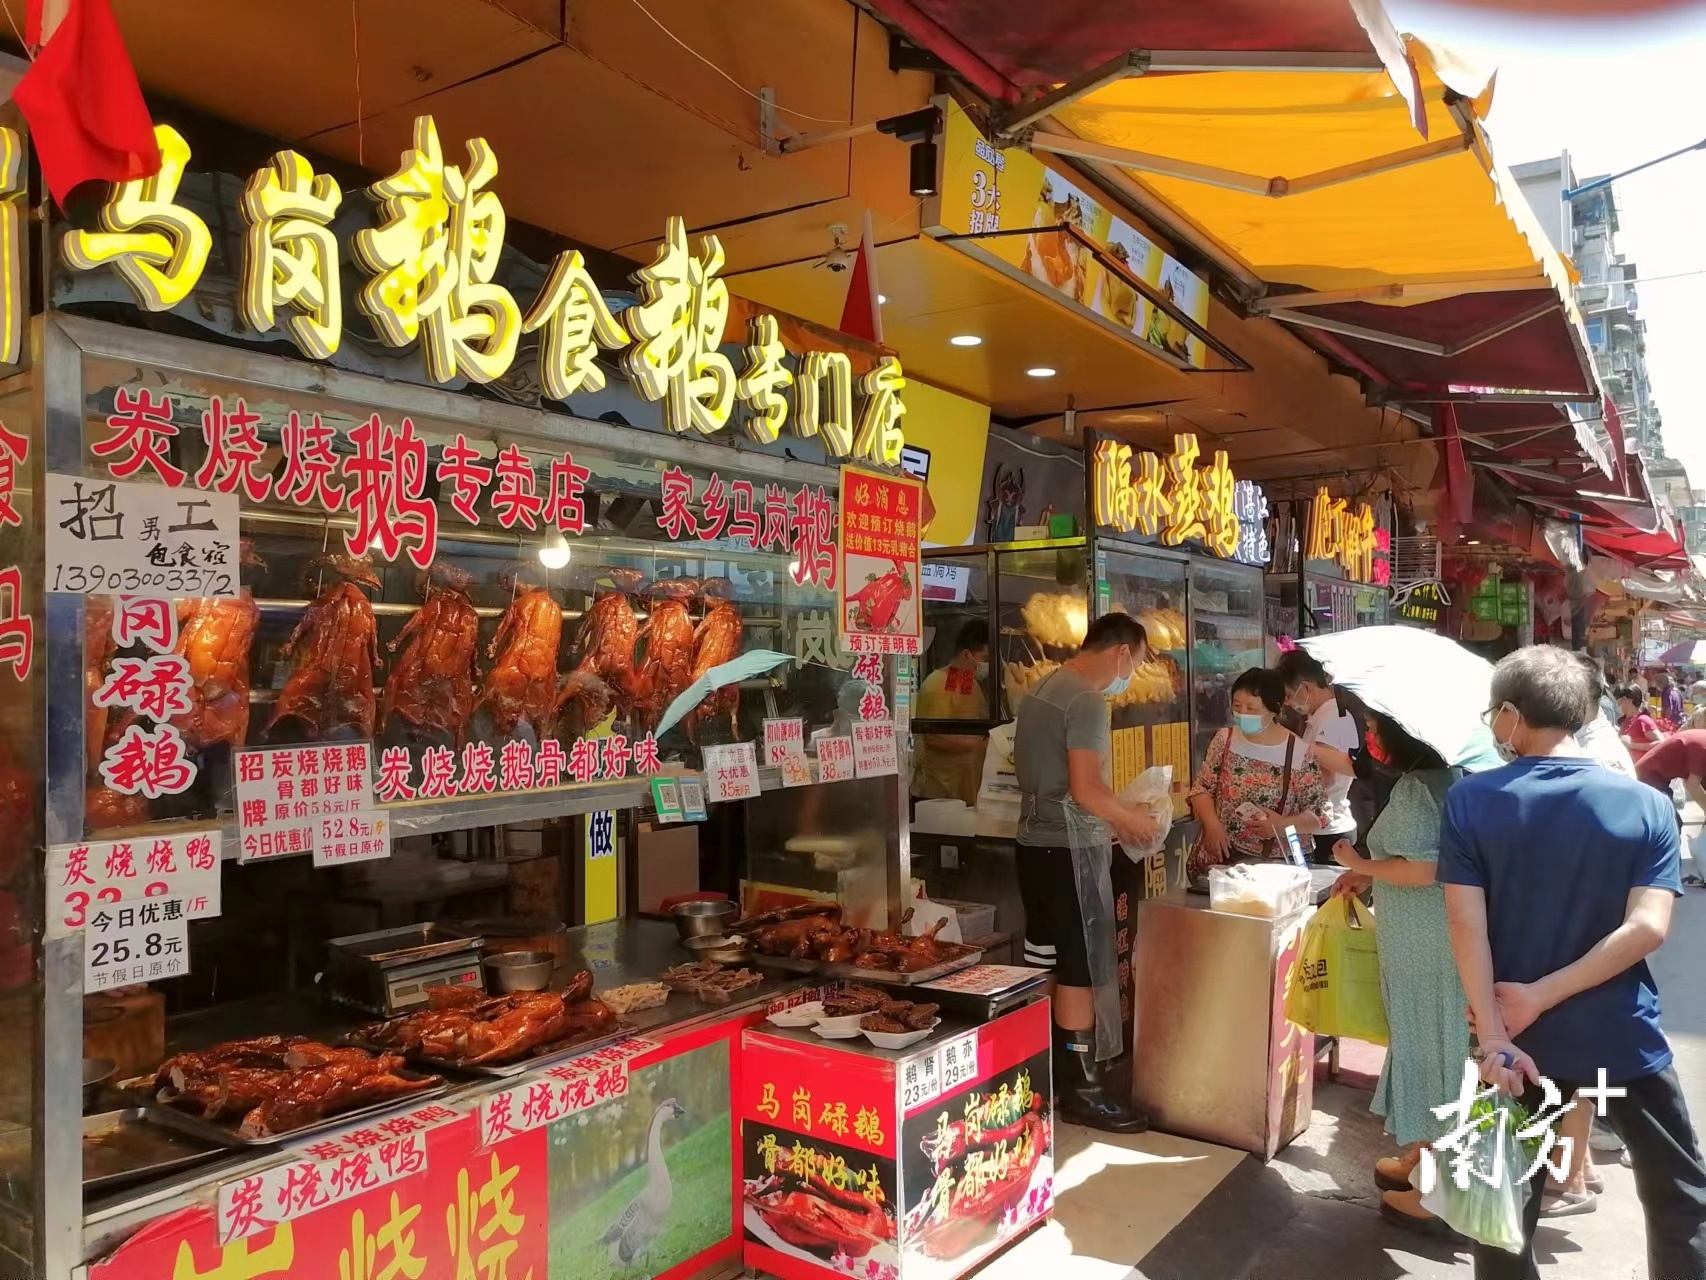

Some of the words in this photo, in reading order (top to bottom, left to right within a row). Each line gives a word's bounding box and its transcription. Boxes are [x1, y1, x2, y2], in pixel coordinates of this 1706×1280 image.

[93, 387, 591, 568] 炭烧烧鹅专卖店
[1094, 433, 1239, 558] 隔水蒸鸡
[60, 482, 124, 541] 招
[138, 516, 160, 541] 男
[168, 499, 219, 533] 工
[854, 481, 910, 516] 好消息
[846, 510, 917, 539] 欢迎预订烧鹅
[52, 563, 237, 597] 13903003372
[849, 635, 919, 655] 预订清明鹅
[853, 653, 889, 721] 碌鹅
[855, 725, 894, 742] 骨都好味
[272, 745, 367, 780] 炭烧烧鹅
[374, 731, 664, 802] 炭烧烧鹅骨都好味
[717, 765, 750, 781] 大优惠
[239, 754, 268, 829] 招牌
[277, 773, 364, 800] 骨都好味
[62, 838, 217, 888] 炭烧烧鸭
[321, 838, 385, 861] 节假日原价
[91, 898, 184, 934] 今日优惠
[91, 931, 183, 968] 25.8元
[93, 958, 182, 986] 节假日原价
[544, 1035, 655, 1081] 炭烧烧鹅
[905, 1055, 935, 1086] 鹅肾
[944, 1060, 976, 1088] 29元/份
[485, 1066, 629, 1146] 炭烧烧鹅
[904, 1077, 938, 1107] 23元/份
[303, 1103, 460, 1161] 炭烧烧鸭
[756, 1082, 885, 1147] 马岗碌鹅
[756, 1133, 886, 1202] 骨都好味
[221, 1136, 427, 1245] 炭烧烧鸭
